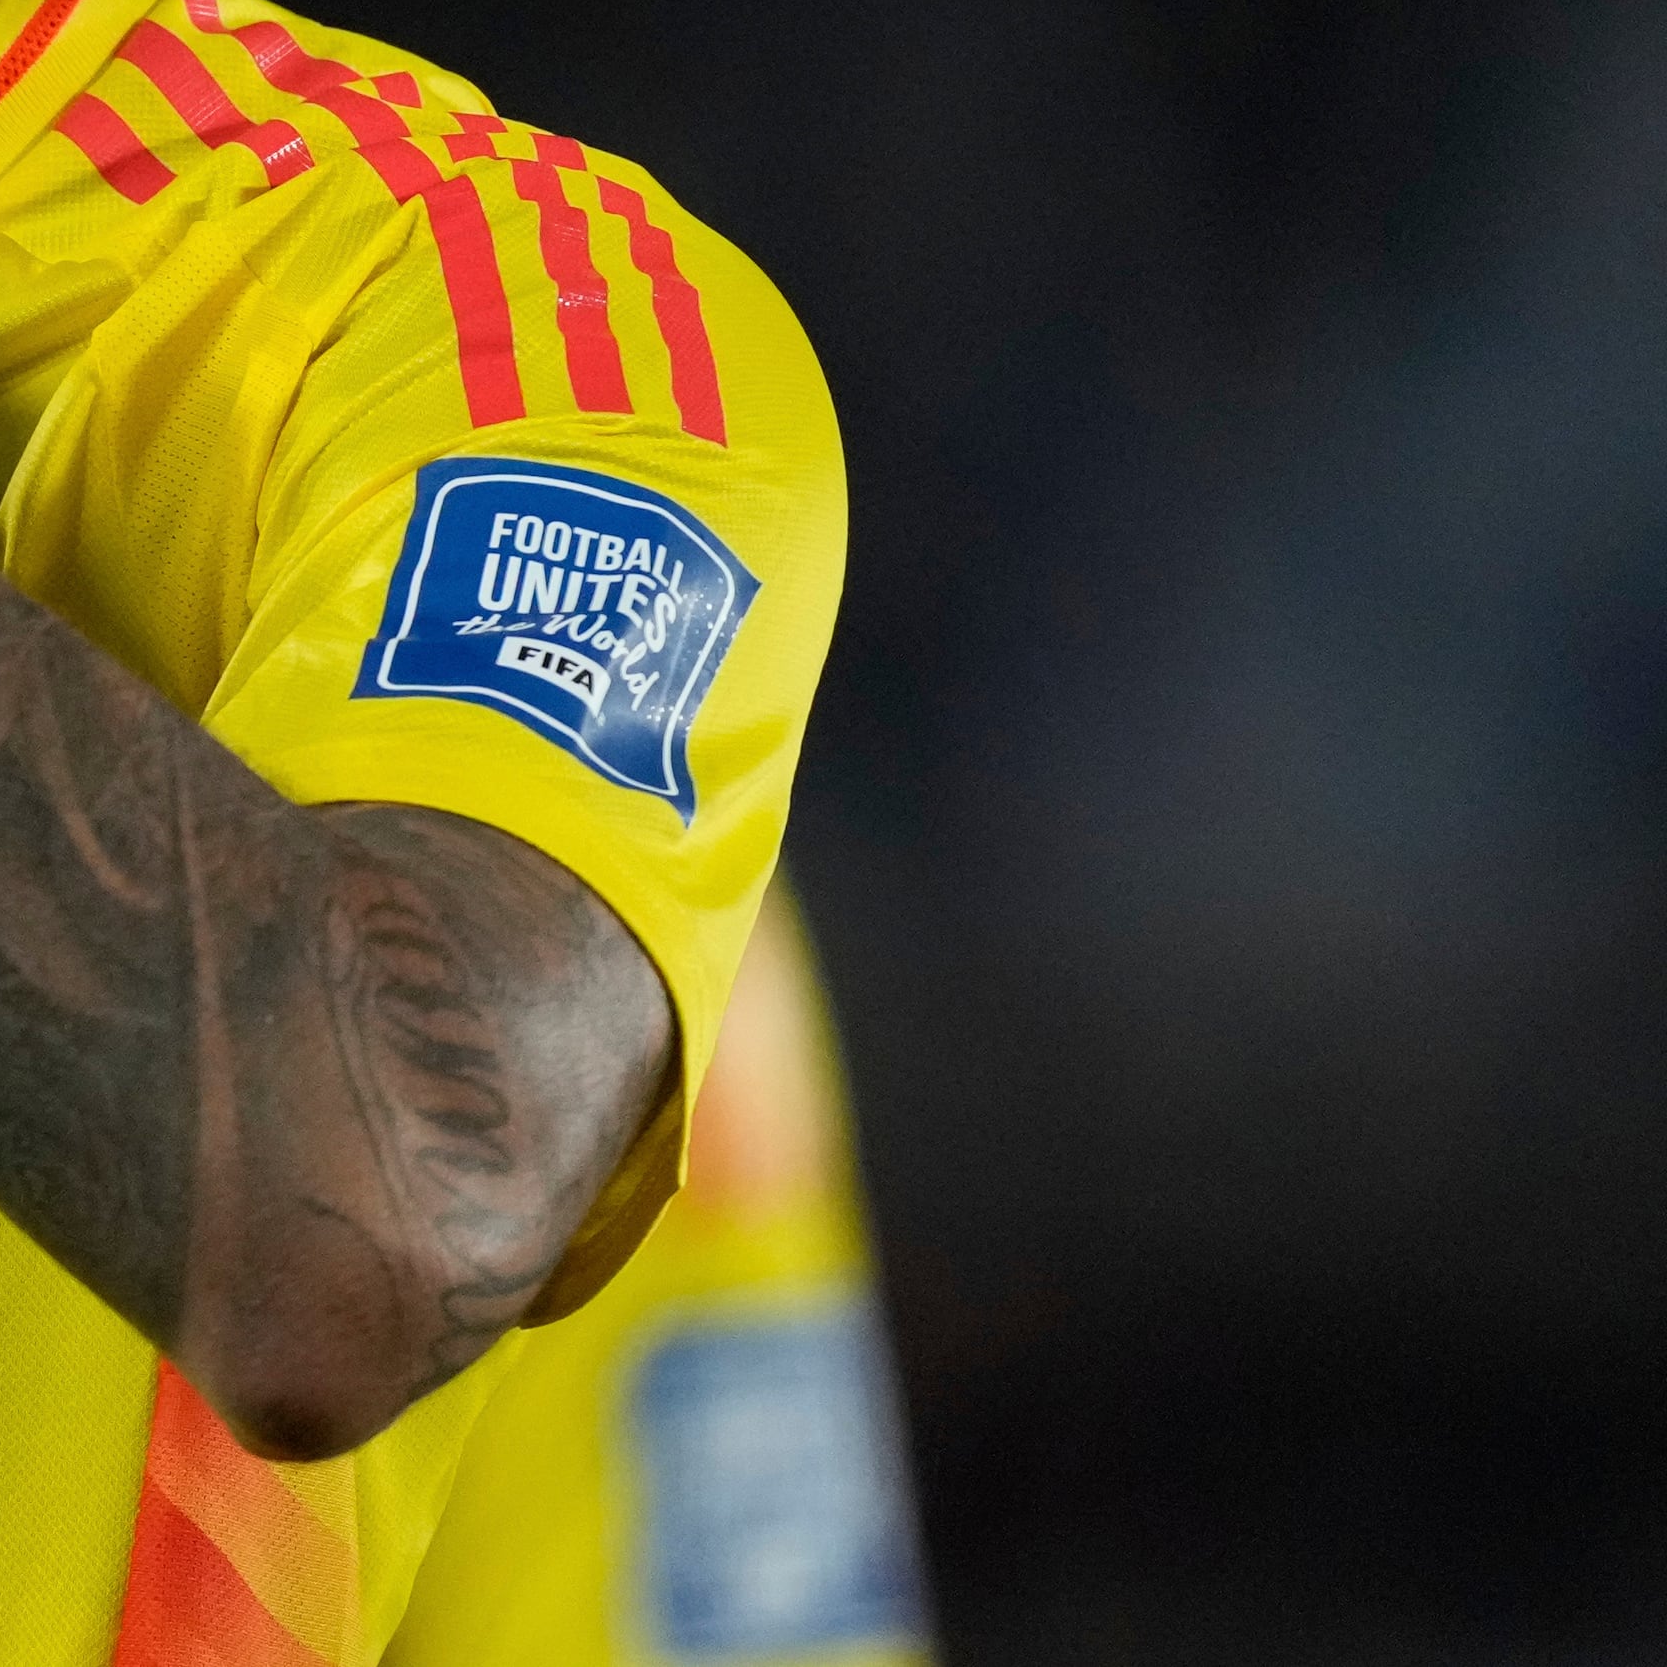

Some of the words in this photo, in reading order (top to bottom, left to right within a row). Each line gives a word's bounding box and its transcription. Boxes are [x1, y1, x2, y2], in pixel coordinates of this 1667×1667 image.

[478, 553, 675, 652] UNITES
[489, 512, 683, 604] FOOTBALL
[452, 613, 535, 636] the
[542, 613, 659, 710] World
[517, 645, 595, 695] FIFA
